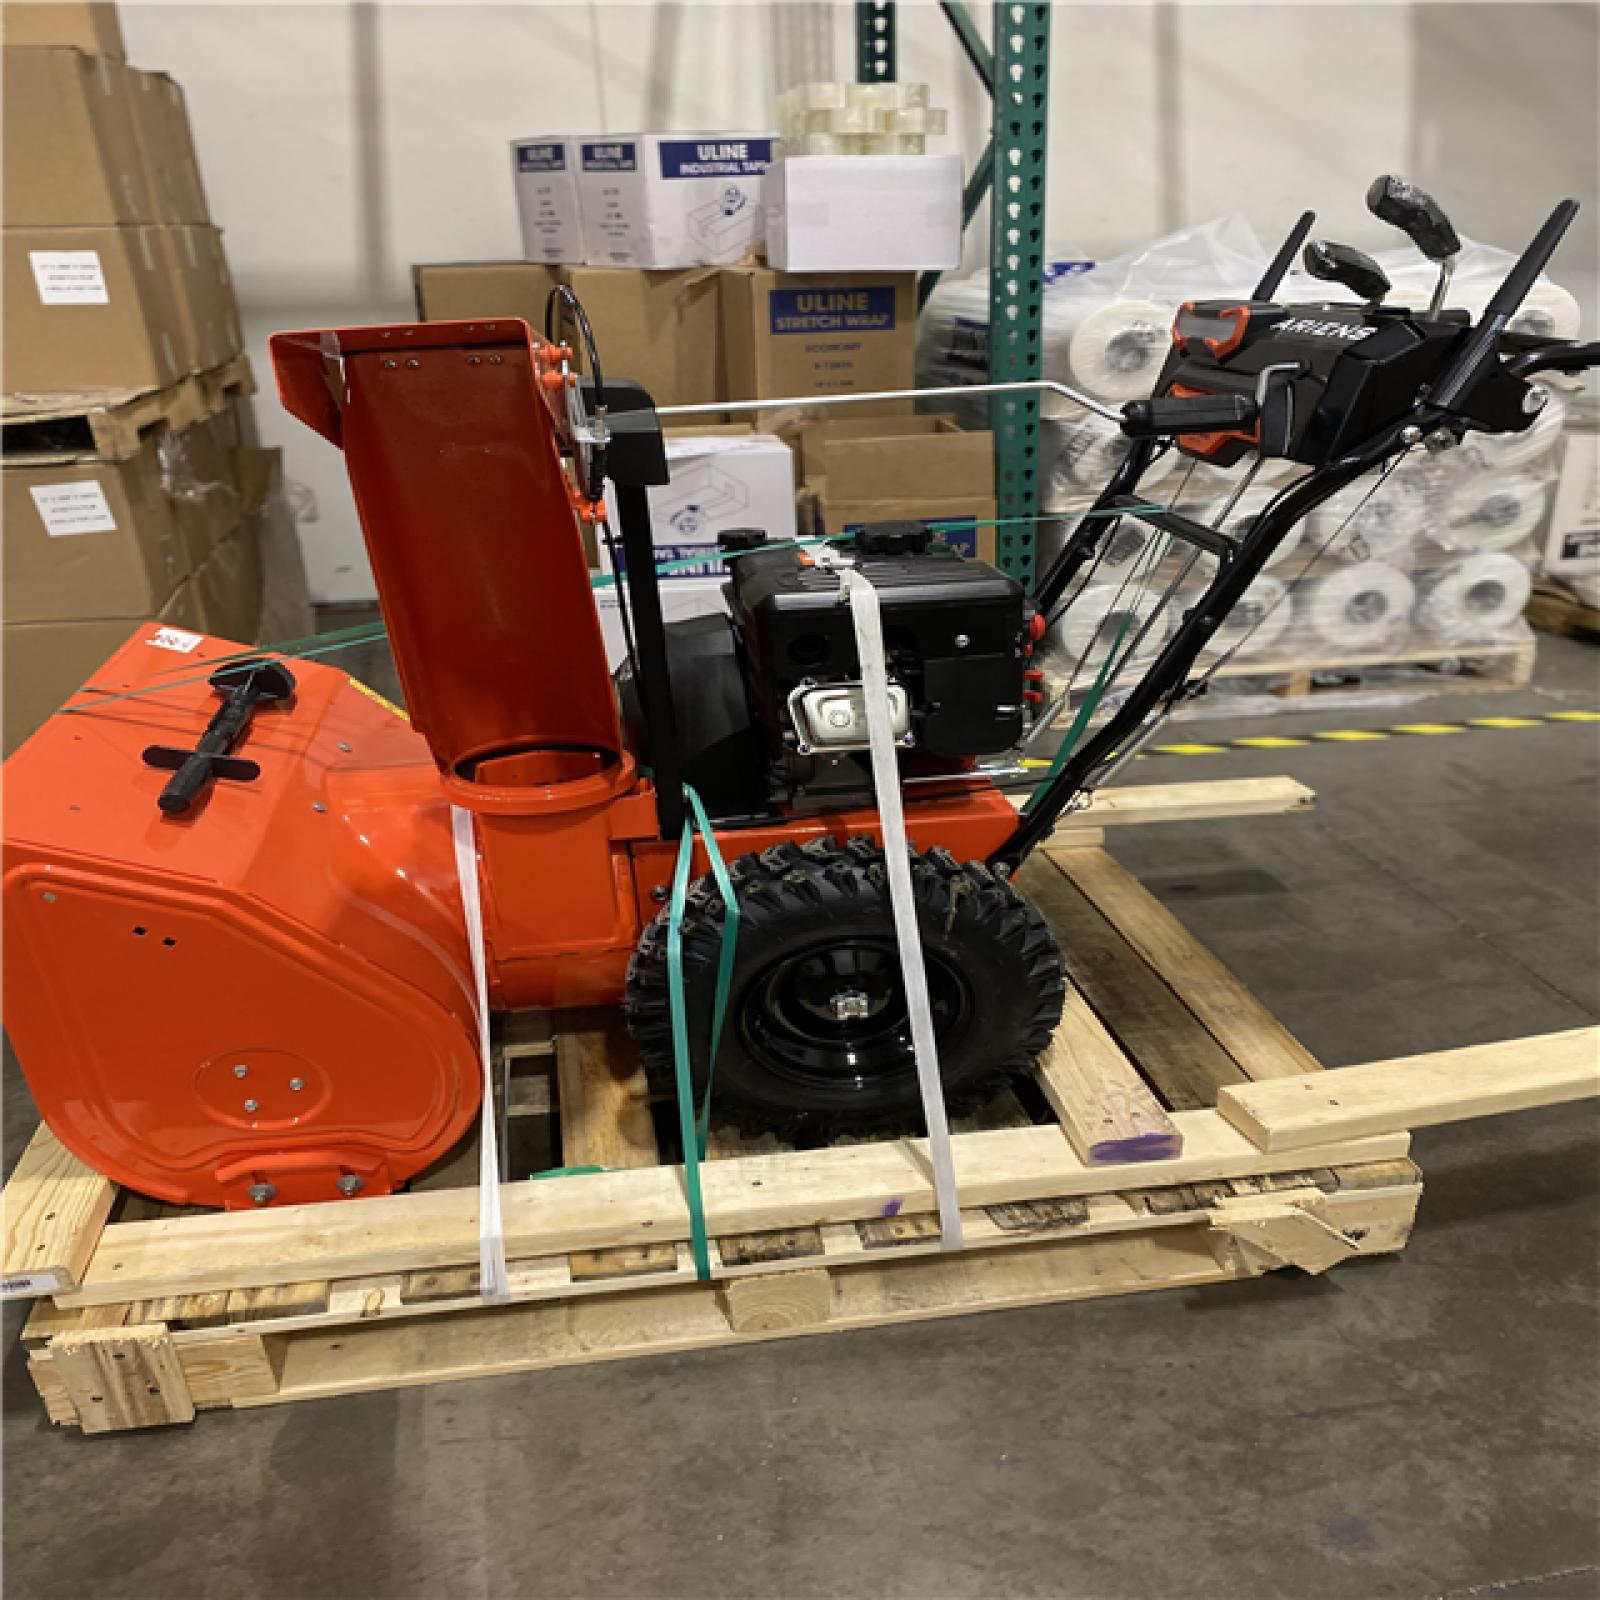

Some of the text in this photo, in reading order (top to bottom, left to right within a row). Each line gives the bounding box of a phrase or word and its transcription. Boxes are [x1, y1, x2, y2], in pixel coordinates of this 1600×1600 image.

[696, 143, 749, 161] ULINE
[796, 292, 869, 313] ULINE
[775, 313, 889, 331] STRETCH WRAP
[1270, 317, 1379, 341] ARIENS
